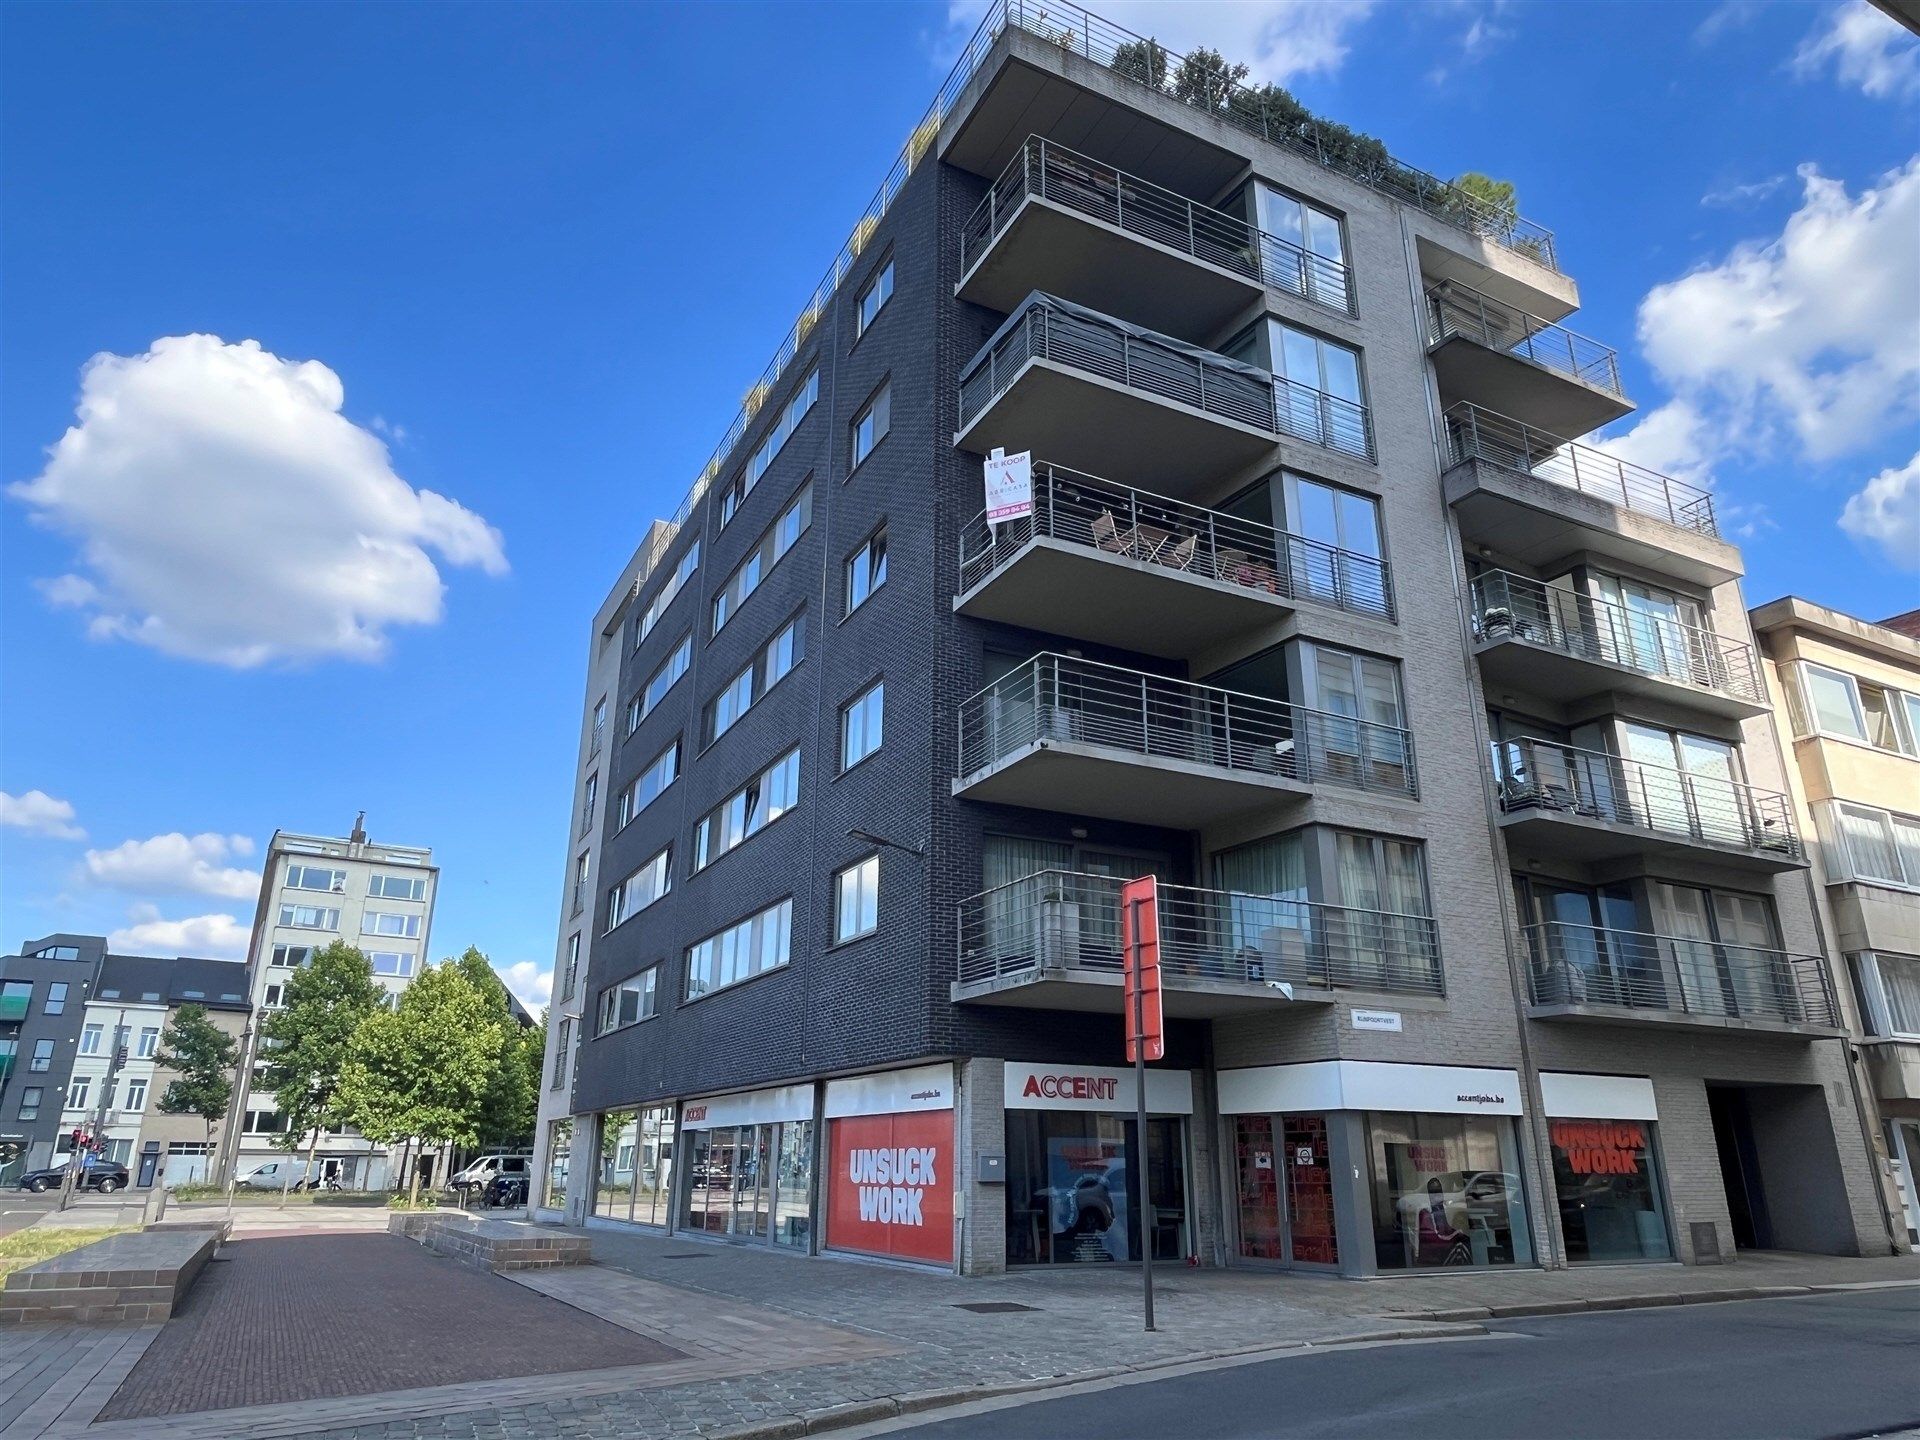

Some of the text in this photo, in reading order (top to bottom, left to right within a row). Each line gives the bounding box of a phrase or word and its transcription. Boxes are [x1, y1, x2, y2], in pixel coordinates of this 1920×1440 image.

[1001, 456, 1025, 467] KOOP
[1022, 1075, 1118, 1100] ACCENT
[1457, 1094, 1504, 1104] accentjobs.be
[1552, 1122, 1646, 1149] UNSUCK
[850, 1147, 936, 1186] UNSUCK
[1568, 1147, 1639, 1174] WORK
[859, 1186, 923, 1226] WORK
